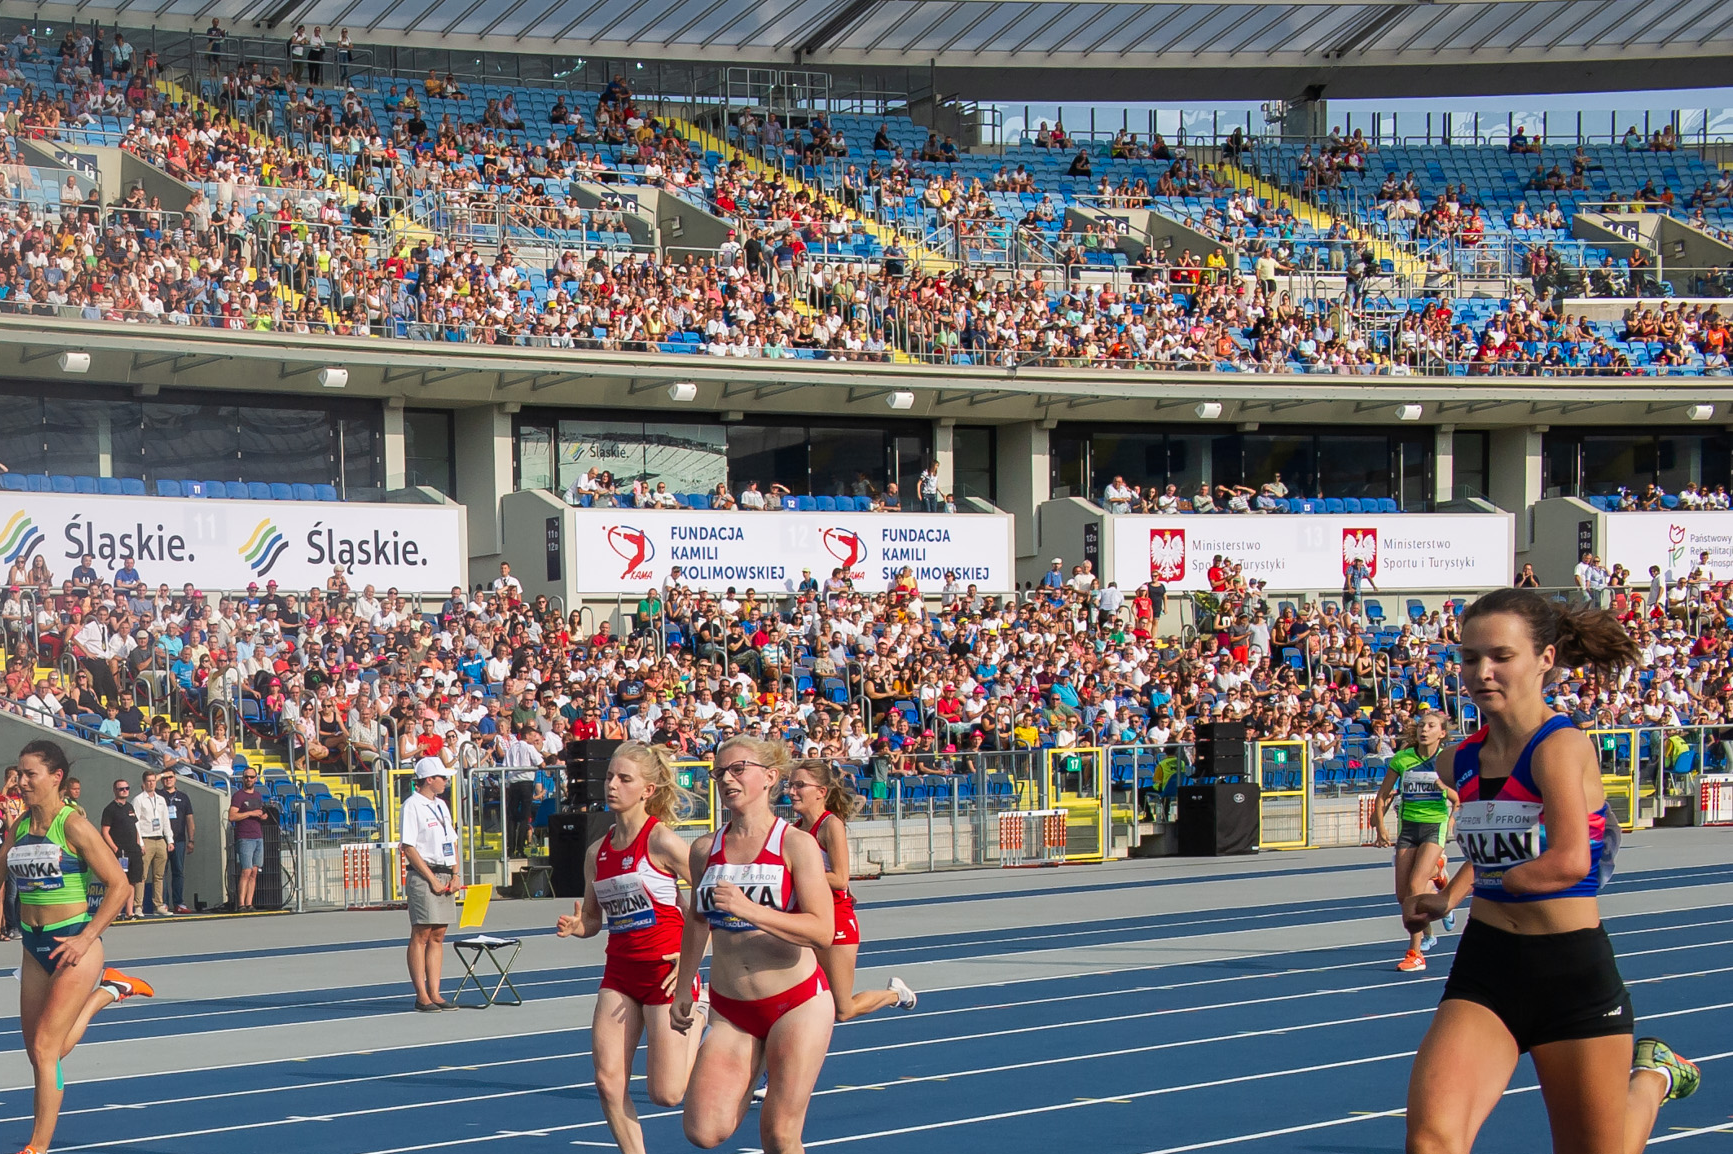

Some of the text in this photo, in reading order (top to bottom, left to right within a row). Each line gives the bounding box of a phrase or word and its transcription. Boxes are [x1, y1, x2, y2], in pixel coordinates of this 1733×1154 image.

[193, 485, 201, 495] 11
[787, 500, 796, 508] 12
[671, 527, 744, 541] FUNDACJA
[882, 529, 951, 543] FUNDACJA
[1690, 533, 1733, 547] Państwowy
[64, 513, 195, 571] Śląskie.
[307, 521, 428, 575] Śląskie.
[1192, 540, 1261, 551] Ministerstwo
[1383, 538, 1451, 550] Ministerstwo
[671, 547, 718, 560] KAMILI
[882, 548, 926, 561] KAMILI
[1239, 557, 1285, 573] Turystyki
[1383, 556, 1475, 571] Sportu i Turystyki
[674, 566, 785, 581] KOLIMOWSKIEJ
[849, 570, 865, 580] AMA
[882, 566, 989, 581] SKIMOWSKIEJ
[1607, 739, 1615, 748] 19
[1277, 752, 1285, 762] 18
[1070, 759, 1078, 769] 17
[680, 775, 689, 785] 16
[1495, 815, 1530, 824] PFRON
[10, 859, 59, 877] MUĆKA
[750, 873, 777, 881] PFRON
